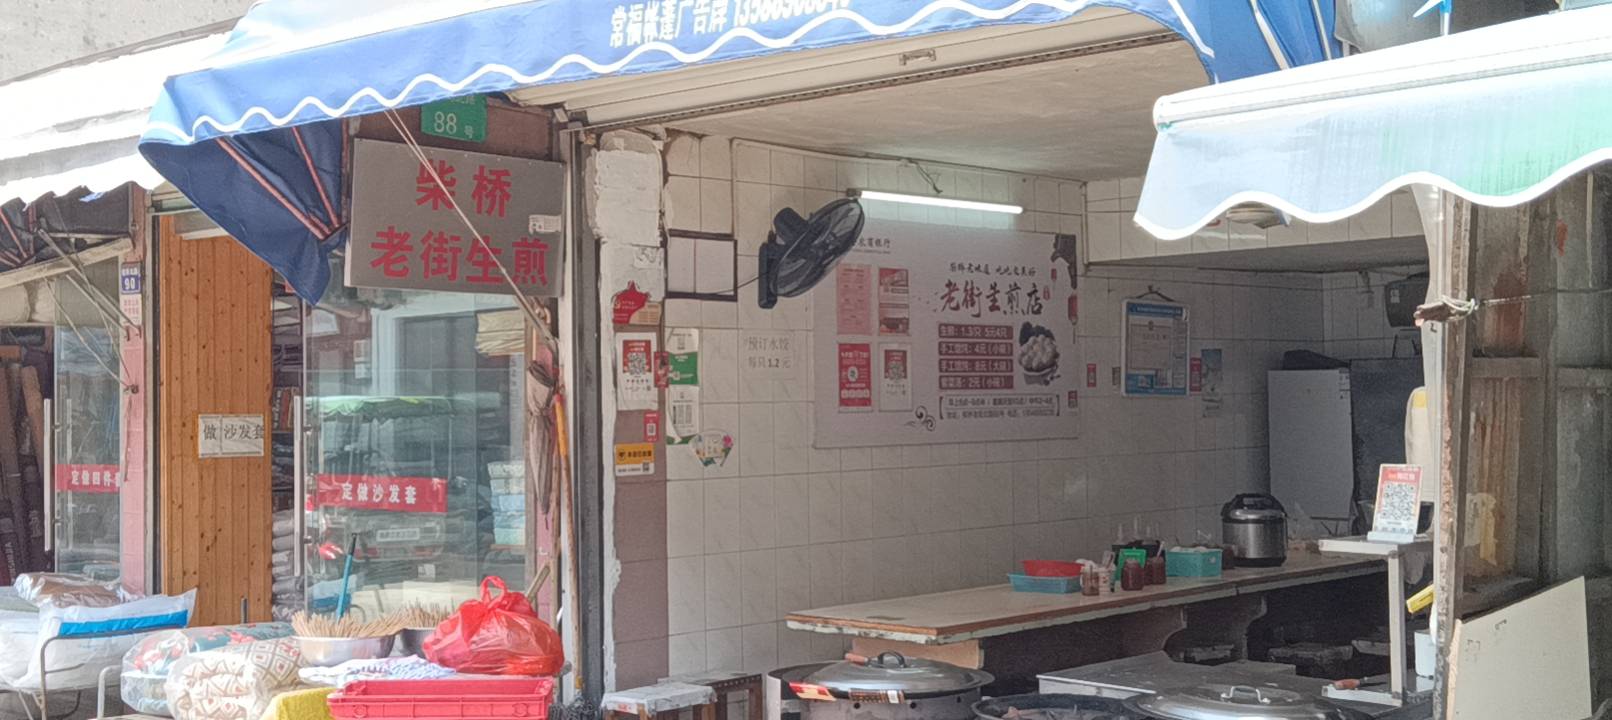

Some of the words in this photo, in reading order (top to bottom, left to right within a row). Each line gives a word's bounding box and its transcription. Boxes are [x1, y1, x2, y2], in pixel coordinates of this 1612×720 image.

[434, 111, 457, 134] 88
[415, 159, 512, 218] 柴桥
[369, 226, 549, 286] 老街生煎
[124, 277, 136, 290] 90
[940, 279, 1043, 318] 老街生煎店
[341, 483, 417, 504] 定做沙发套
